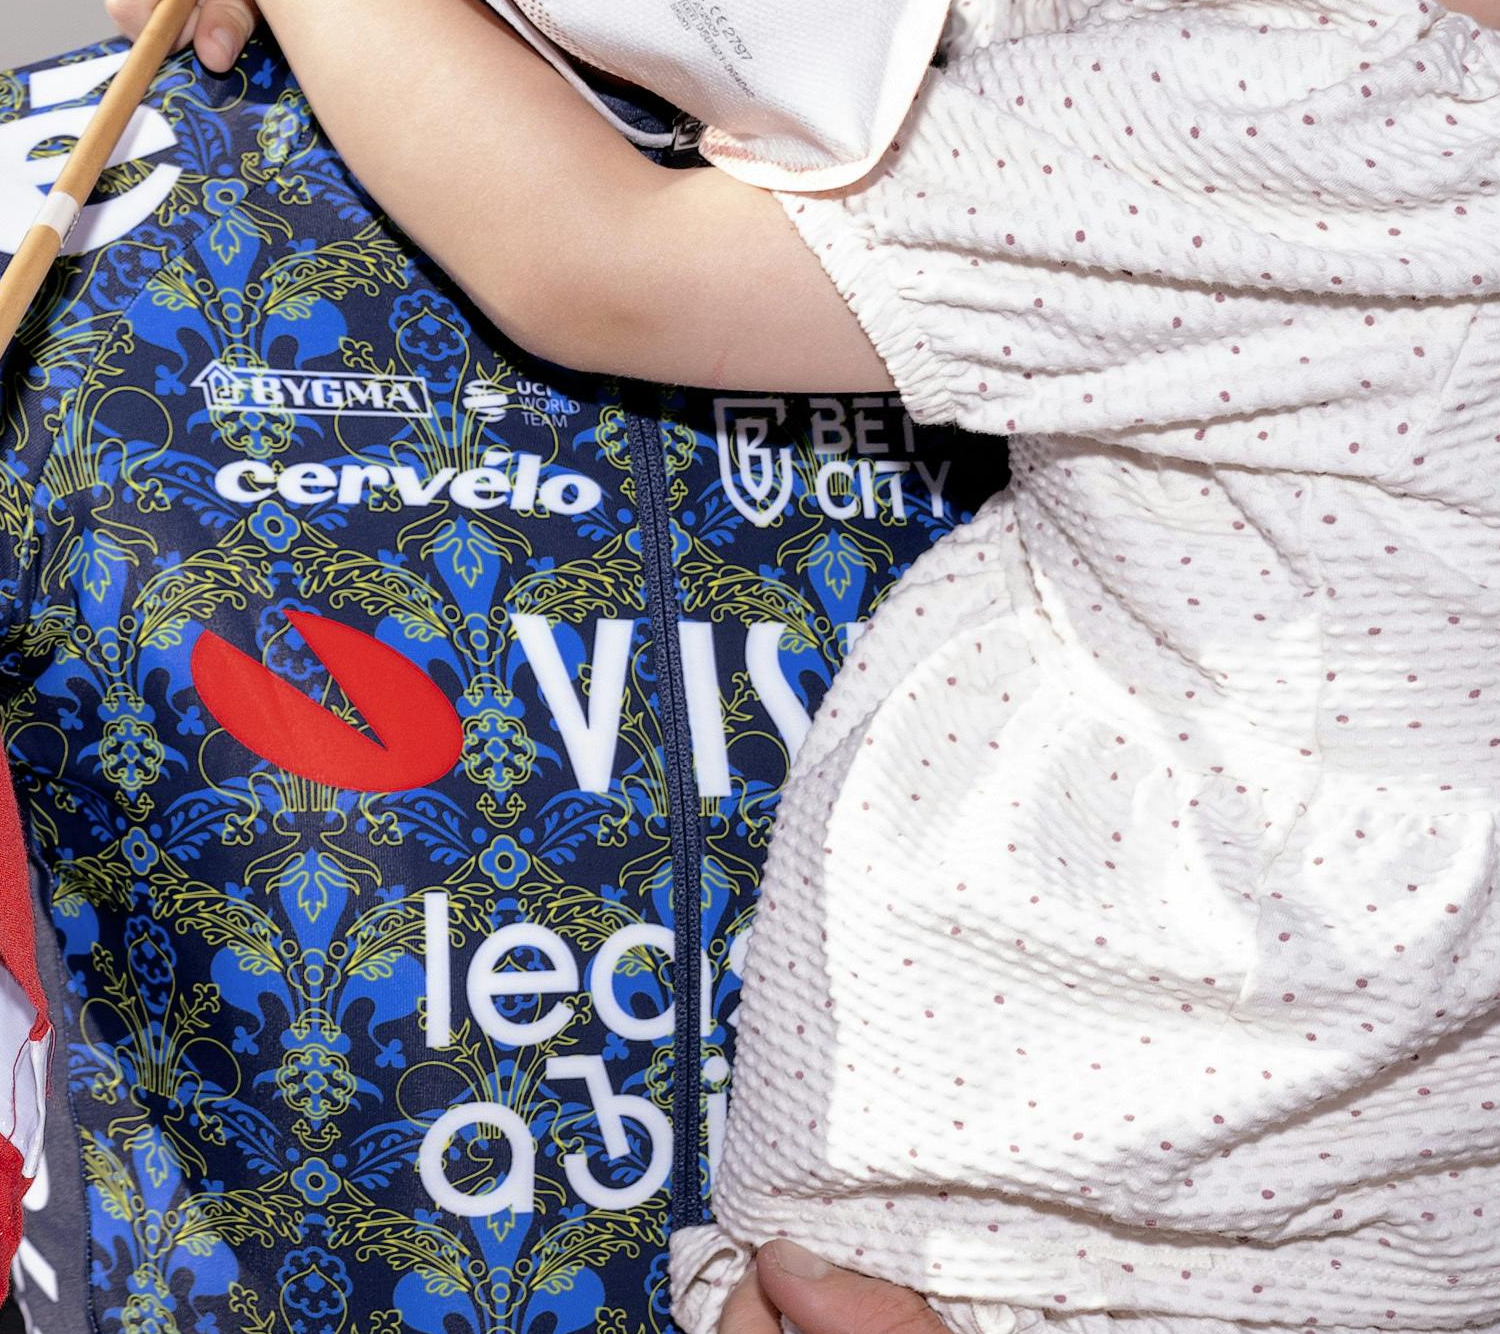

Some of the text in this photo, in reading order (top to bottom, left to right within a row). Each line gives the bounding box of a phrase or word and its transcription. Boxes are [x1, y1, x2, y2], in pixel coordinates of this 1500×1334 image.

[722, 25, 753, 63] 2797
[249, 377, 422, 411] BYGMA
[516, 380, 552, 397] UCI
[517, 396, 580, 414] WORLD
[519, 412, 569, 429] TEAM
[808, 397, 915, 455] BET
[213, 453, 602, 515] cervélo
[815, 460, 951, 520] CITY
[510, 613, 864, 797] VIS
[424, 892, 752, 1048] lea
